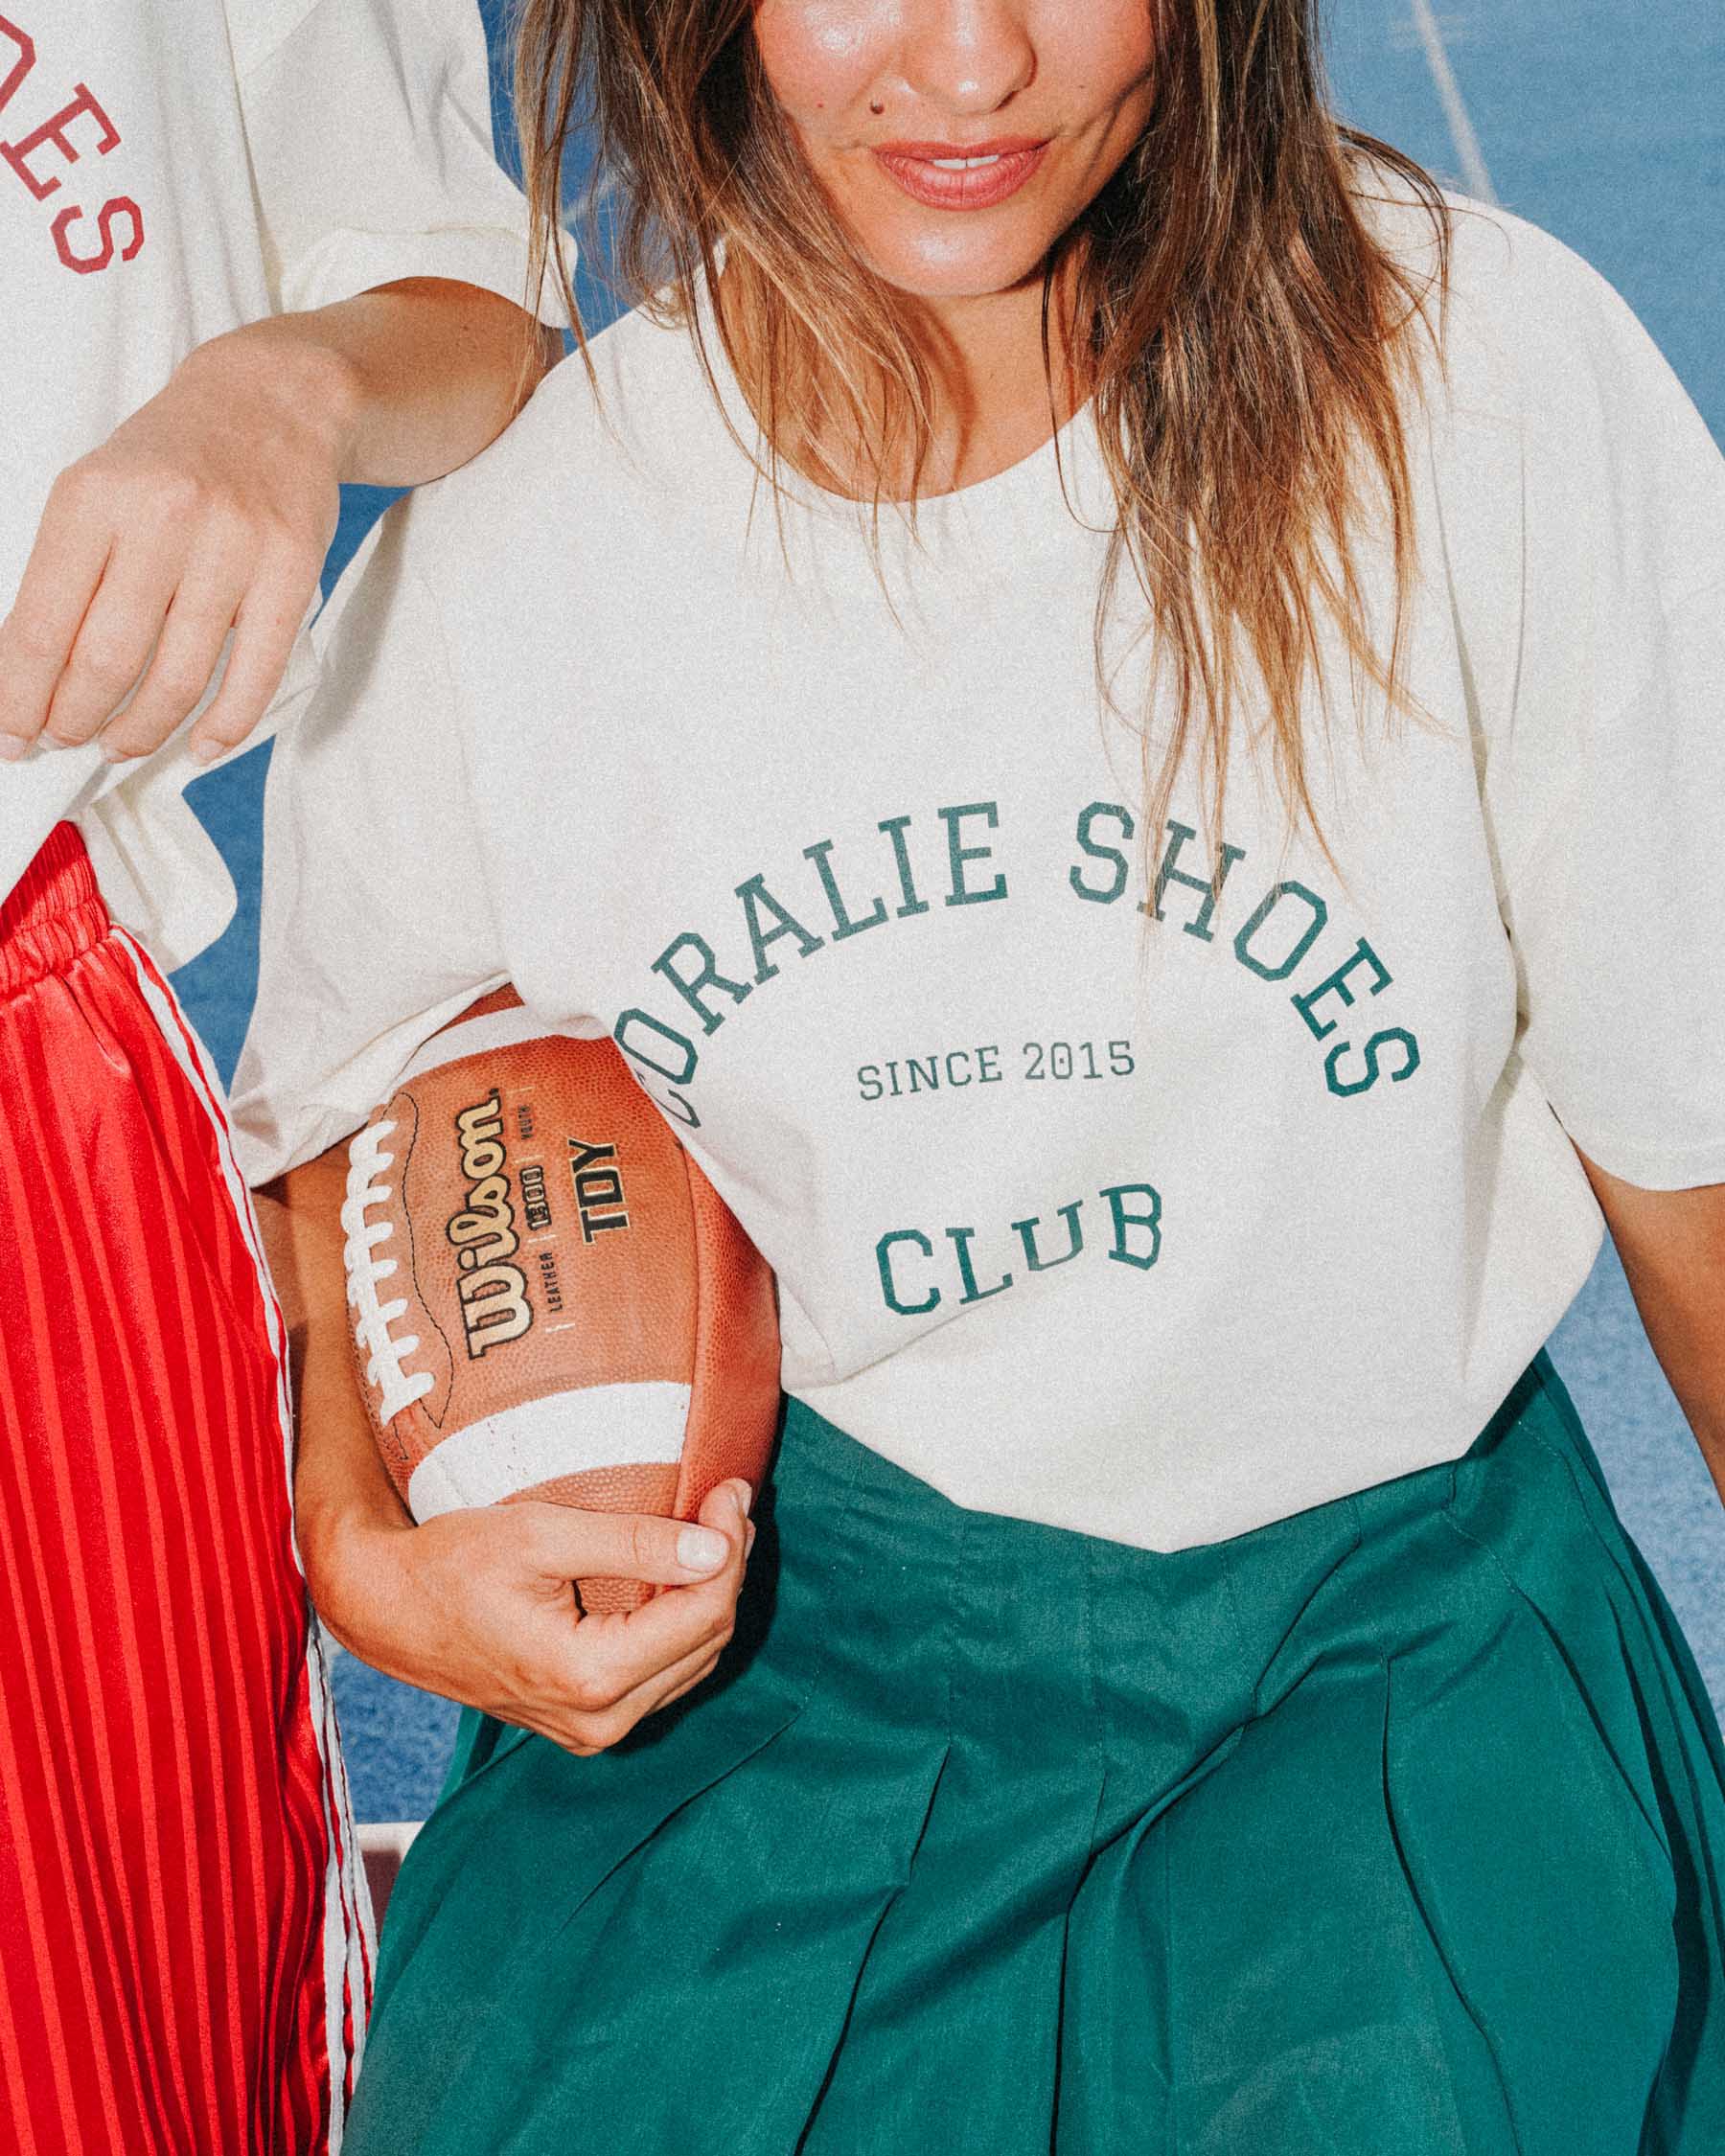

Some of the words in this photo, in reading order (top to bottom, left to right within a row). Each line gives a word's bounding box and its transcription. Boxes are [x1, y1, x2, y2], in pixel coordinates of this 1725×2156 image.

[1070, 801, 1420, 1097] SHOES
[857, 1045, 1002, 1101] SINCE
[1023, 1041, 1135, 1080] 2015
[446, 1095, 534, 1360] Wilson
[567, 1136, 631, 1247] TDY
[876, 1183, 1162, 1315] CLUB
[539, 1251, 564, 1313] LEATHER
